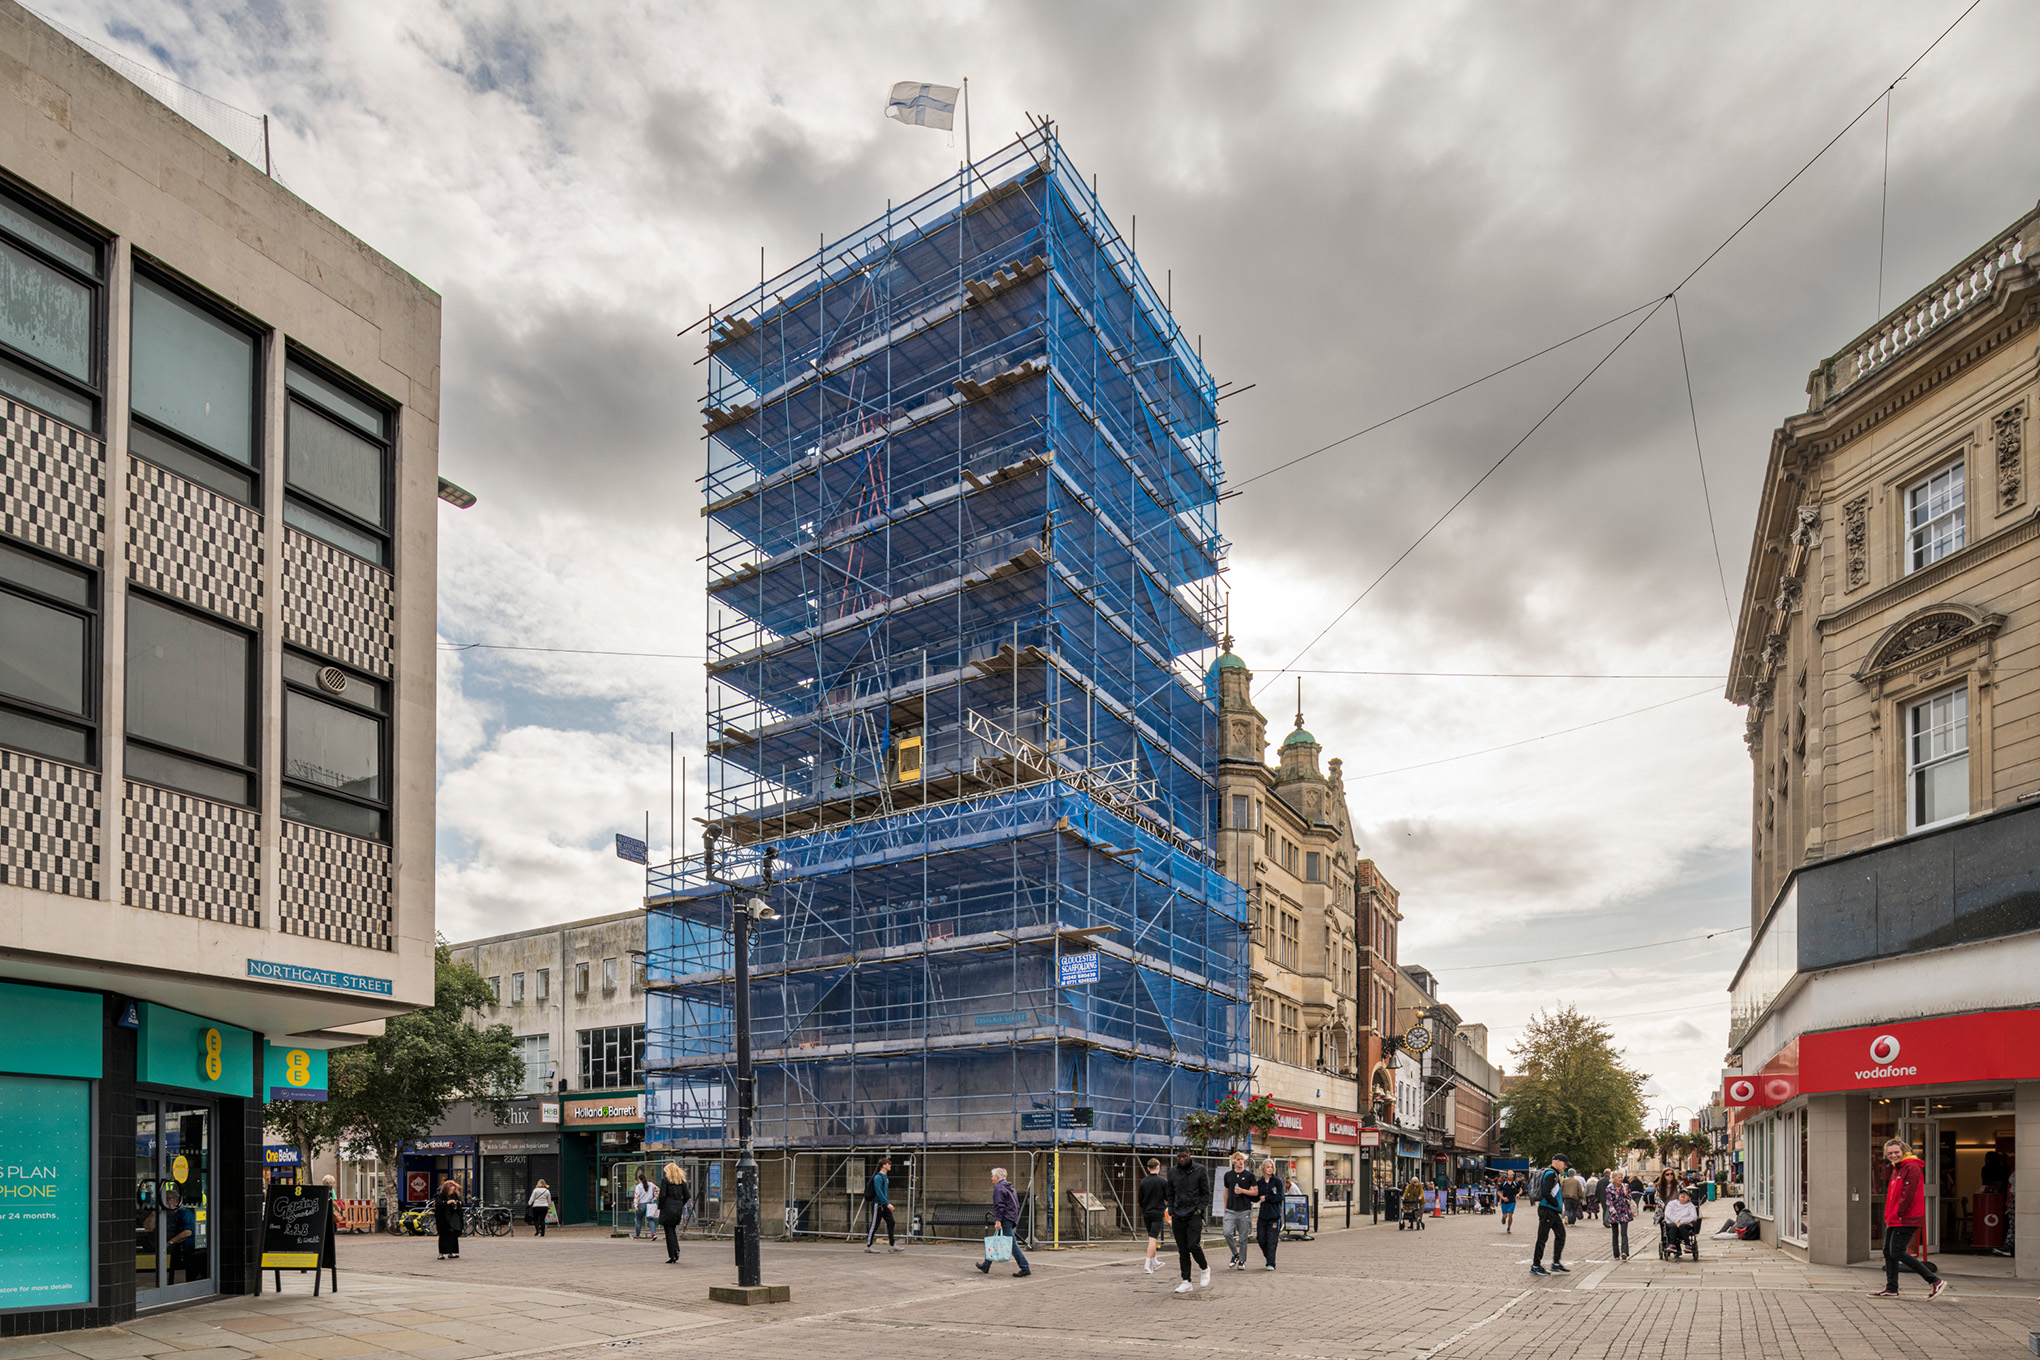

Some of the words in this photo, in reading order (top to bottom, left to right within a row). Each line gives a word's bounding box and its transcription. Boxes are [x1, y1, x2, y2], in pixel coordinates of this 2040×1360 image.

[1062, 953, 1097, 965] GLOUCESTER
[1062, 961, 1098, 973] SCAFFOLDING
[250, 961, 337, 985] NORTHGATE
[343, 976, 390, 992] STREET
[1855, 1065, 1917, 1080] vodafone
[574, 1107, 603, 1118] Holland
[608, 1105, 636, 1117] Barrett
[266, 1149, 278, 1163] One
[8, 1166, 56, 1178] PLAN
[0, 1185, 56, 1198] HONE
[23, 1212, 56, 1220] months
